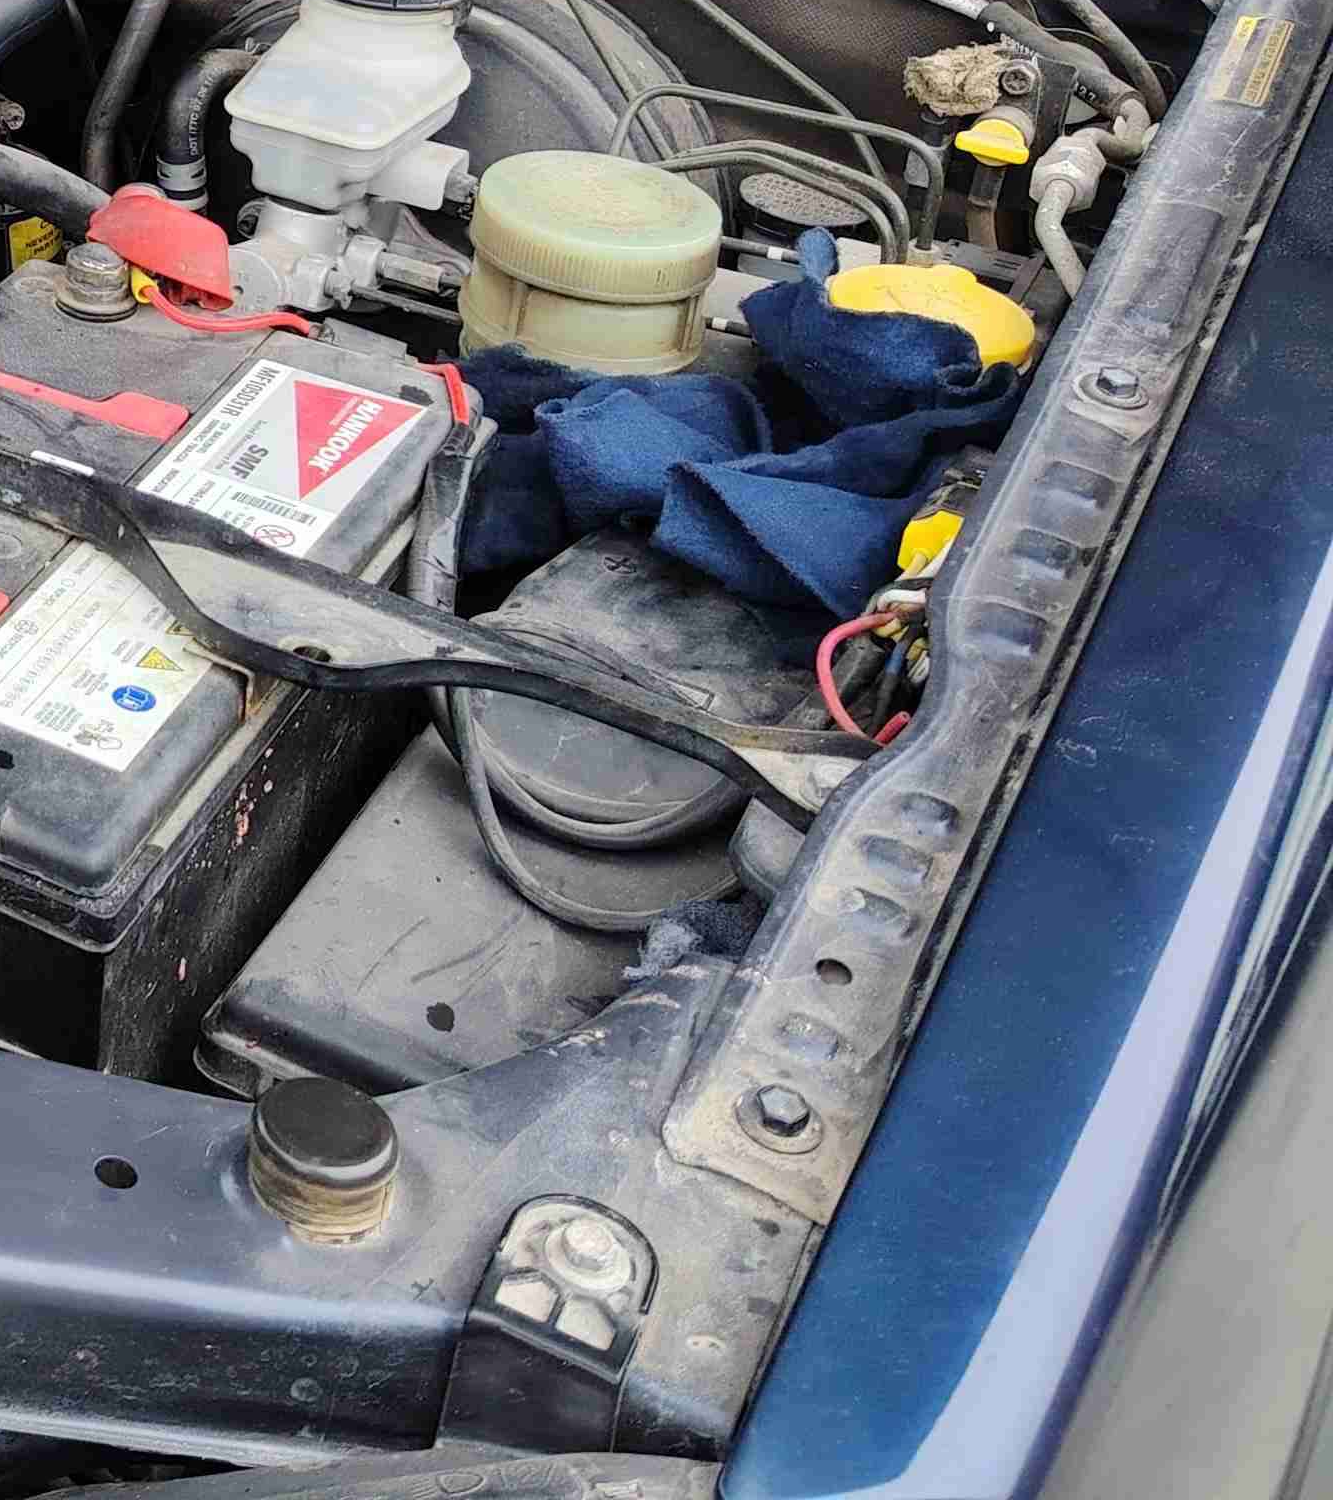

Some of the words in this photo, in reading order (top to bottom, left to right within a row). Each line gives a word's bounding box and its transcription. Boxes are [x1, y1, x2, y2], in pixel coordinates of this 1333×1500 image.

[219, 366, 280, 418] MF105D31R
[229, 443, 269, 480] SMF
[308, 400, 383, 475] HANKOOK
